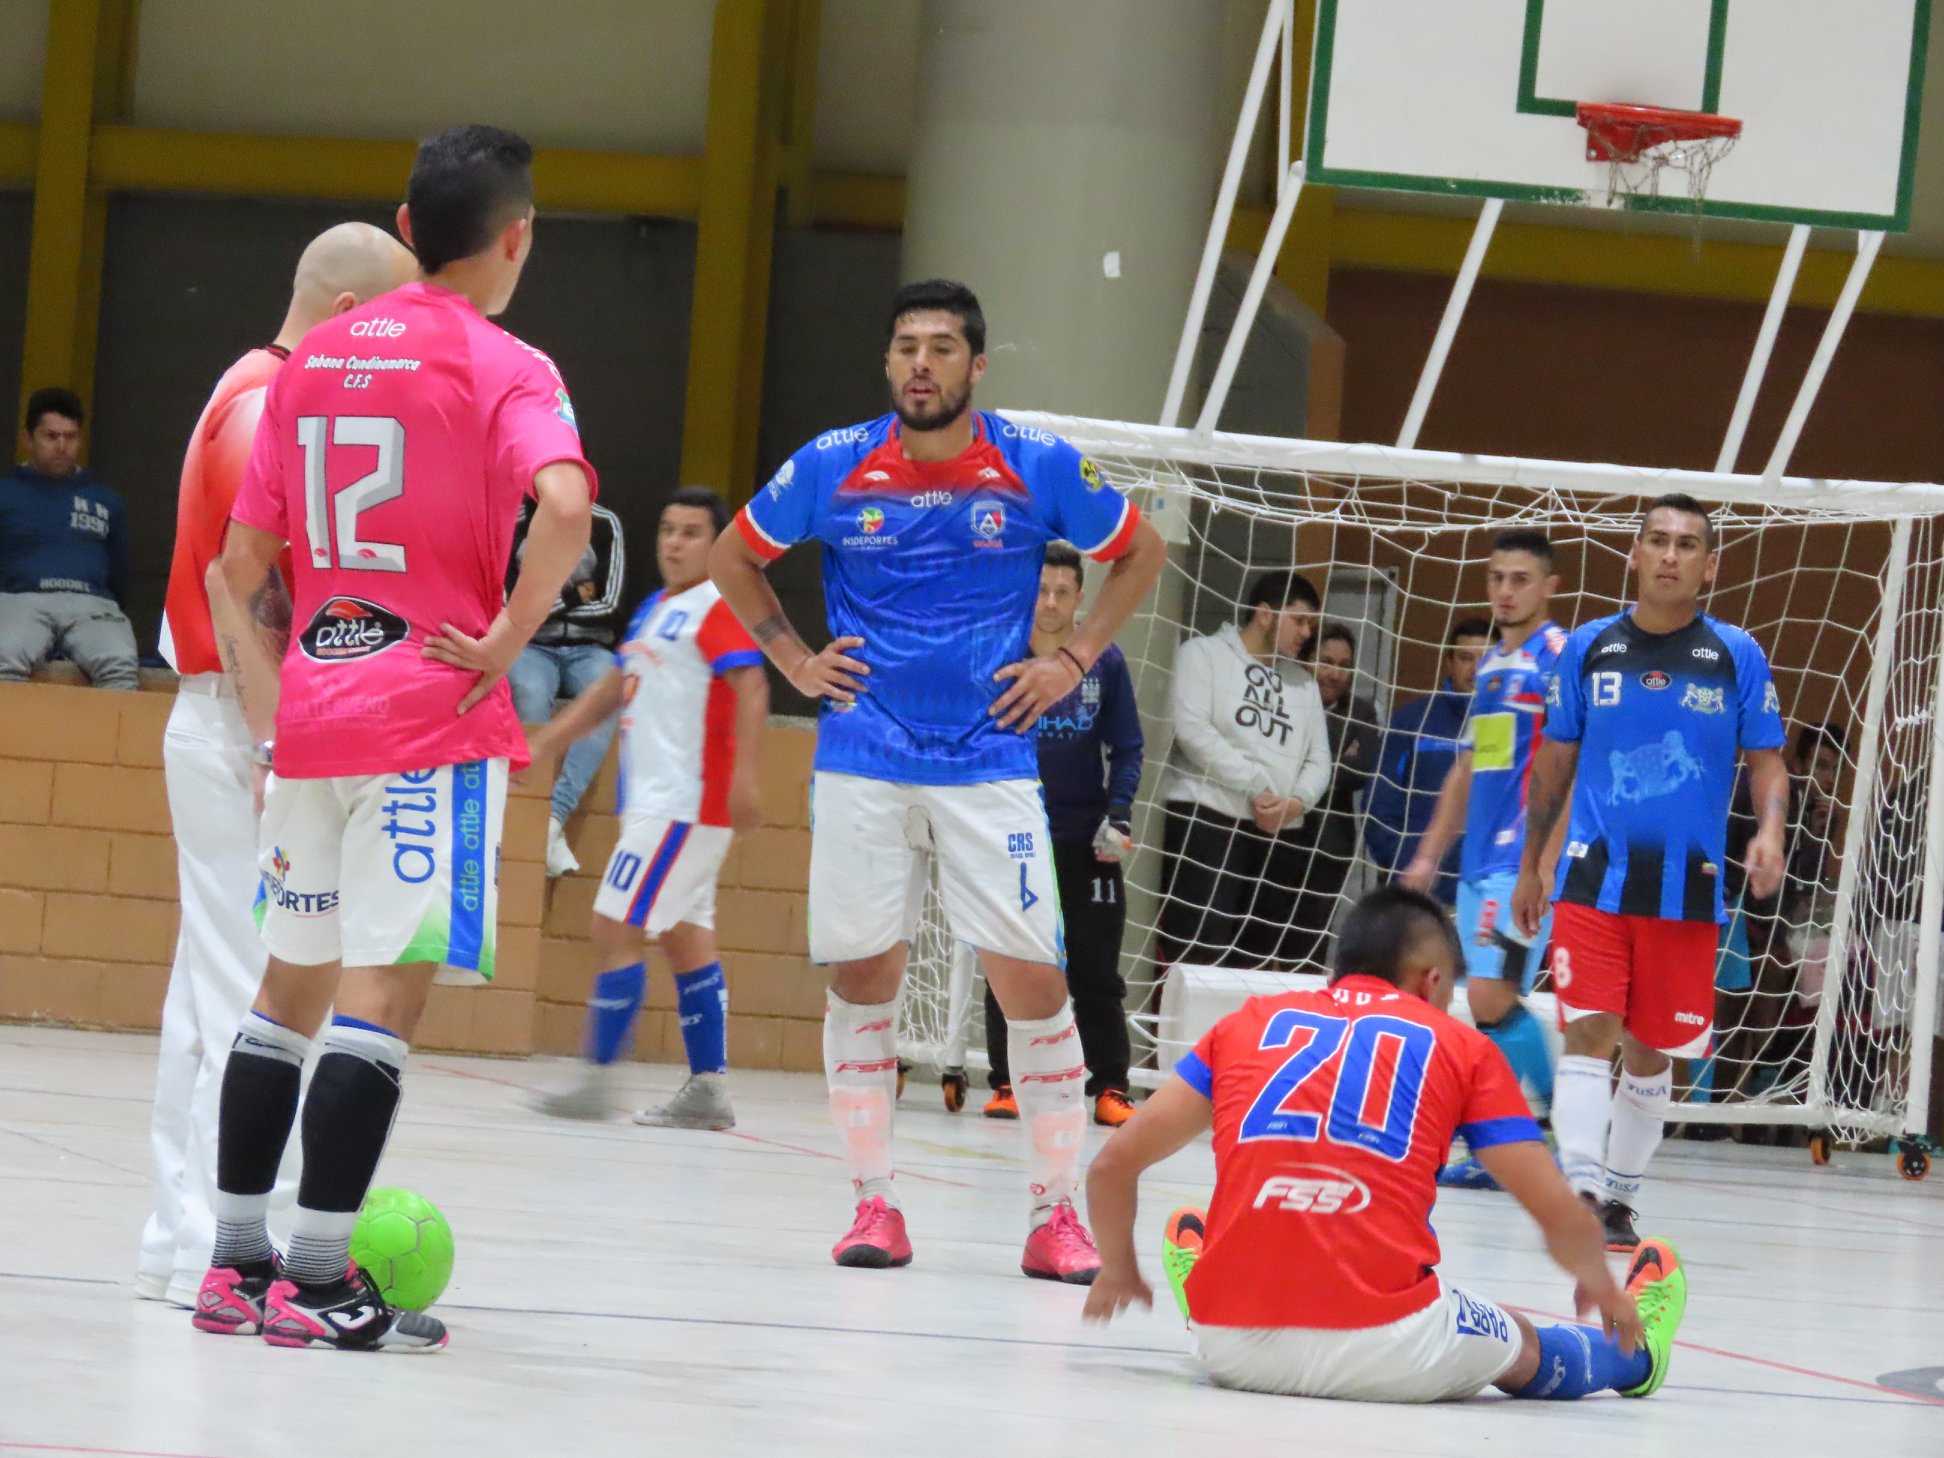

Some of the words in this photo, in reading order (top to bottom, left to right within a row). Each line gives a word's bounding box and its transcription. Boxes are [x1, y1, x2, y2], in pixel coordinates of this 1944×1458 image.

[350, 318, 406, 337] attle
[816, 428, 869, 450] attle
[297, 415, 407, 573] 12
[316, 620, 384, 647] attle
[1592, 671, 1623, 706] 13
[1036, 715, 1094, 731] IHAD
[1007, 832, 1034, 852] CRS
[1090, 877, 1117, 904] 11
[1237, 1008, 1436, 1162] 20
[1252, 1175, 1358, 1215] FSS
